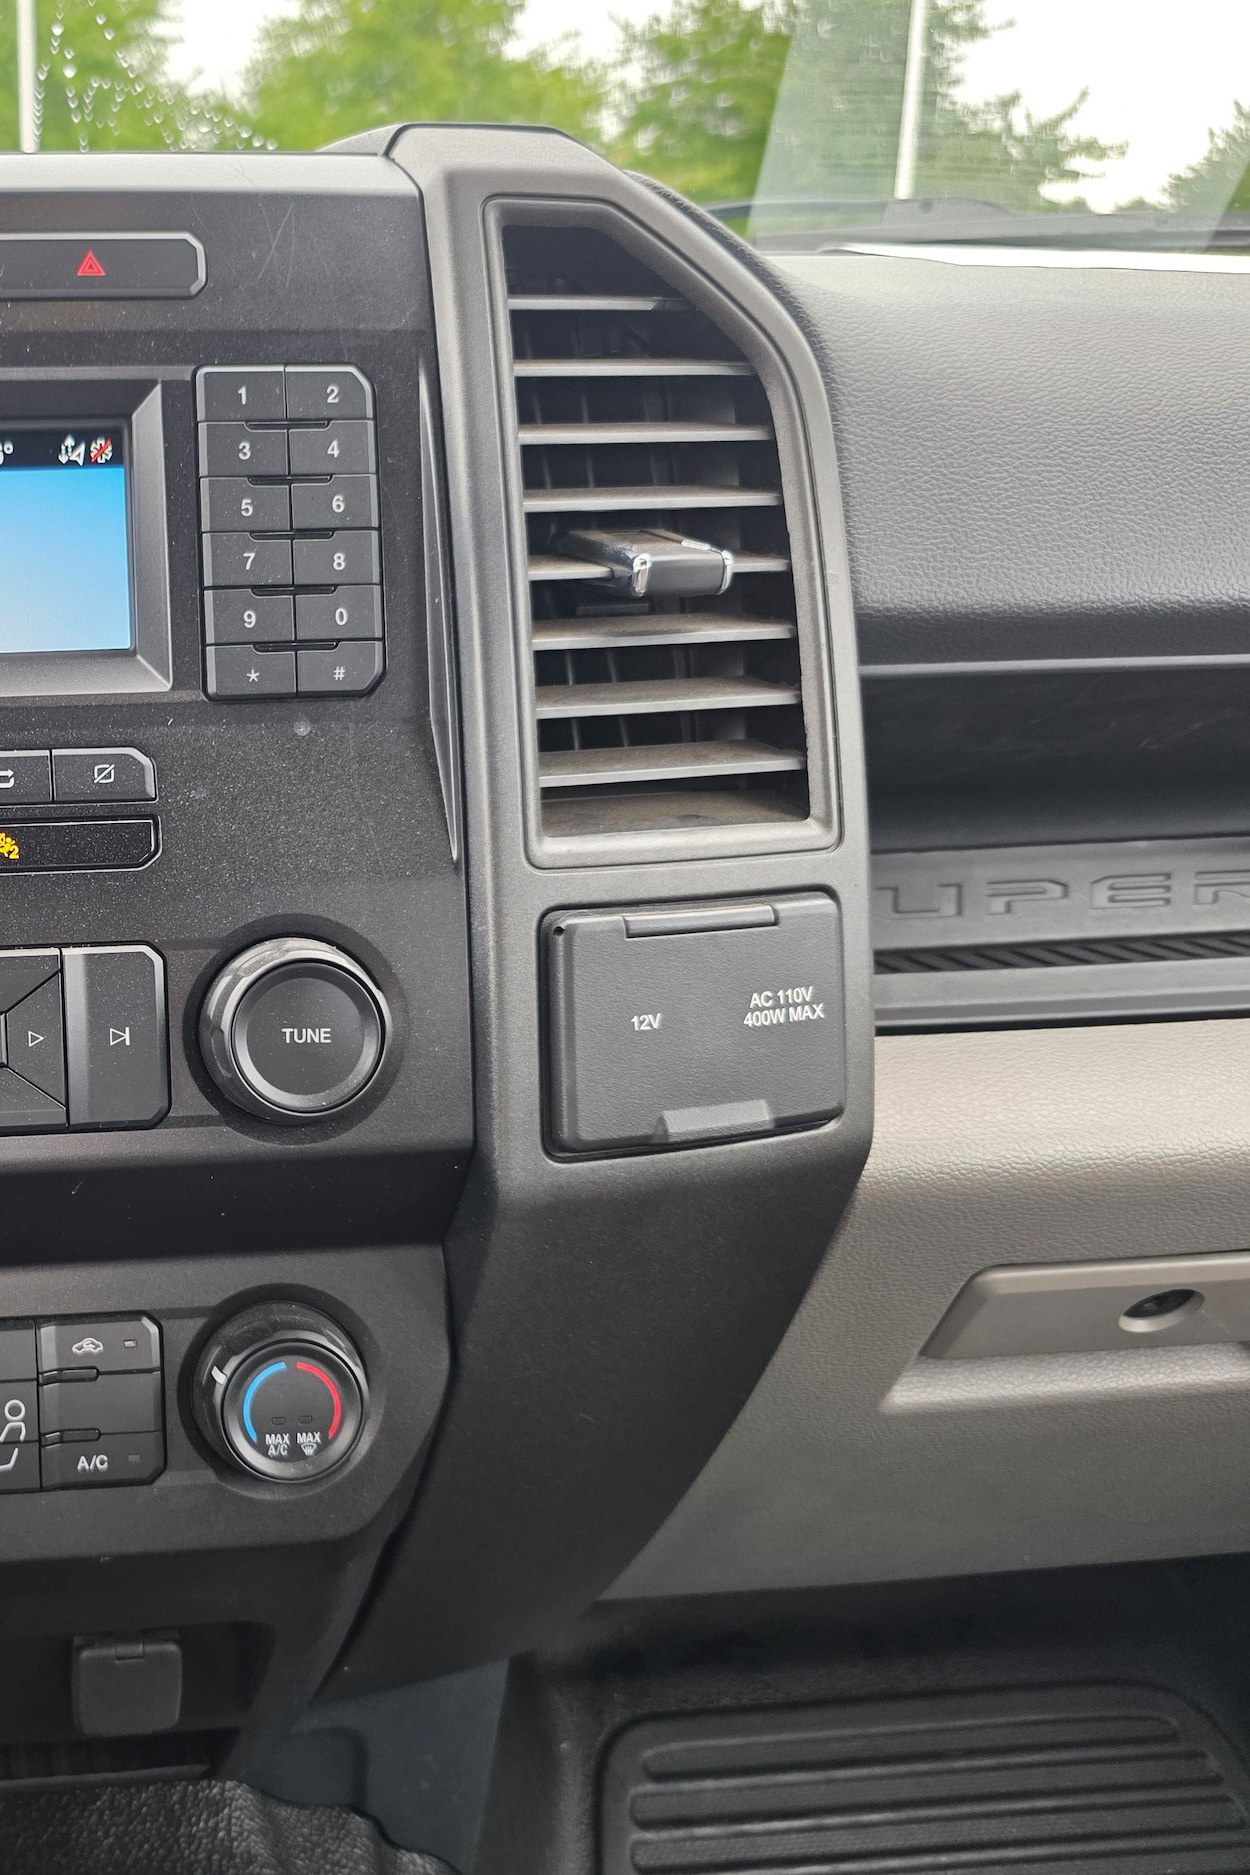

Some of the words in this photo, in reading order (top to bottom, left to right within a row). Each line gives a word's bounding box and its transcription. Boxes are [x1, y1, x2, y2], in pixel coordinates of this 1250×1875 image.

[238, 386, 247, 405] 1
[326, 385, 339, 404] 2
[238, 442, 251, 460] 3
[327, 440, 340, 458] 4
[240, 499, 253, 517] 5
[331, 495, 345, 513] 6
[243, 552, 255, 570] 7
[333, 552, 346, 571] 8
[243, 610, 256, 628] 9
[335, 607, 348, 626] 0
[874, 869, 1250, 920] UPER
[749, 992, 773, 1009] AC
[777, 986, 814, 1006] 110V
[630, 1013, 662, 1031] 12V
[744, 1007, 787, 1028] 400W
[788, 1003, 825, 1022] MAX
[282, 1027, 332, 1044] TUNE
[265, 1432, 290, 1445] MAX
[296, 1431, 321, 1444] MAX
[267, 1443, 289, 1456] A/C
[77, 1453, 109, 1471] A/C
